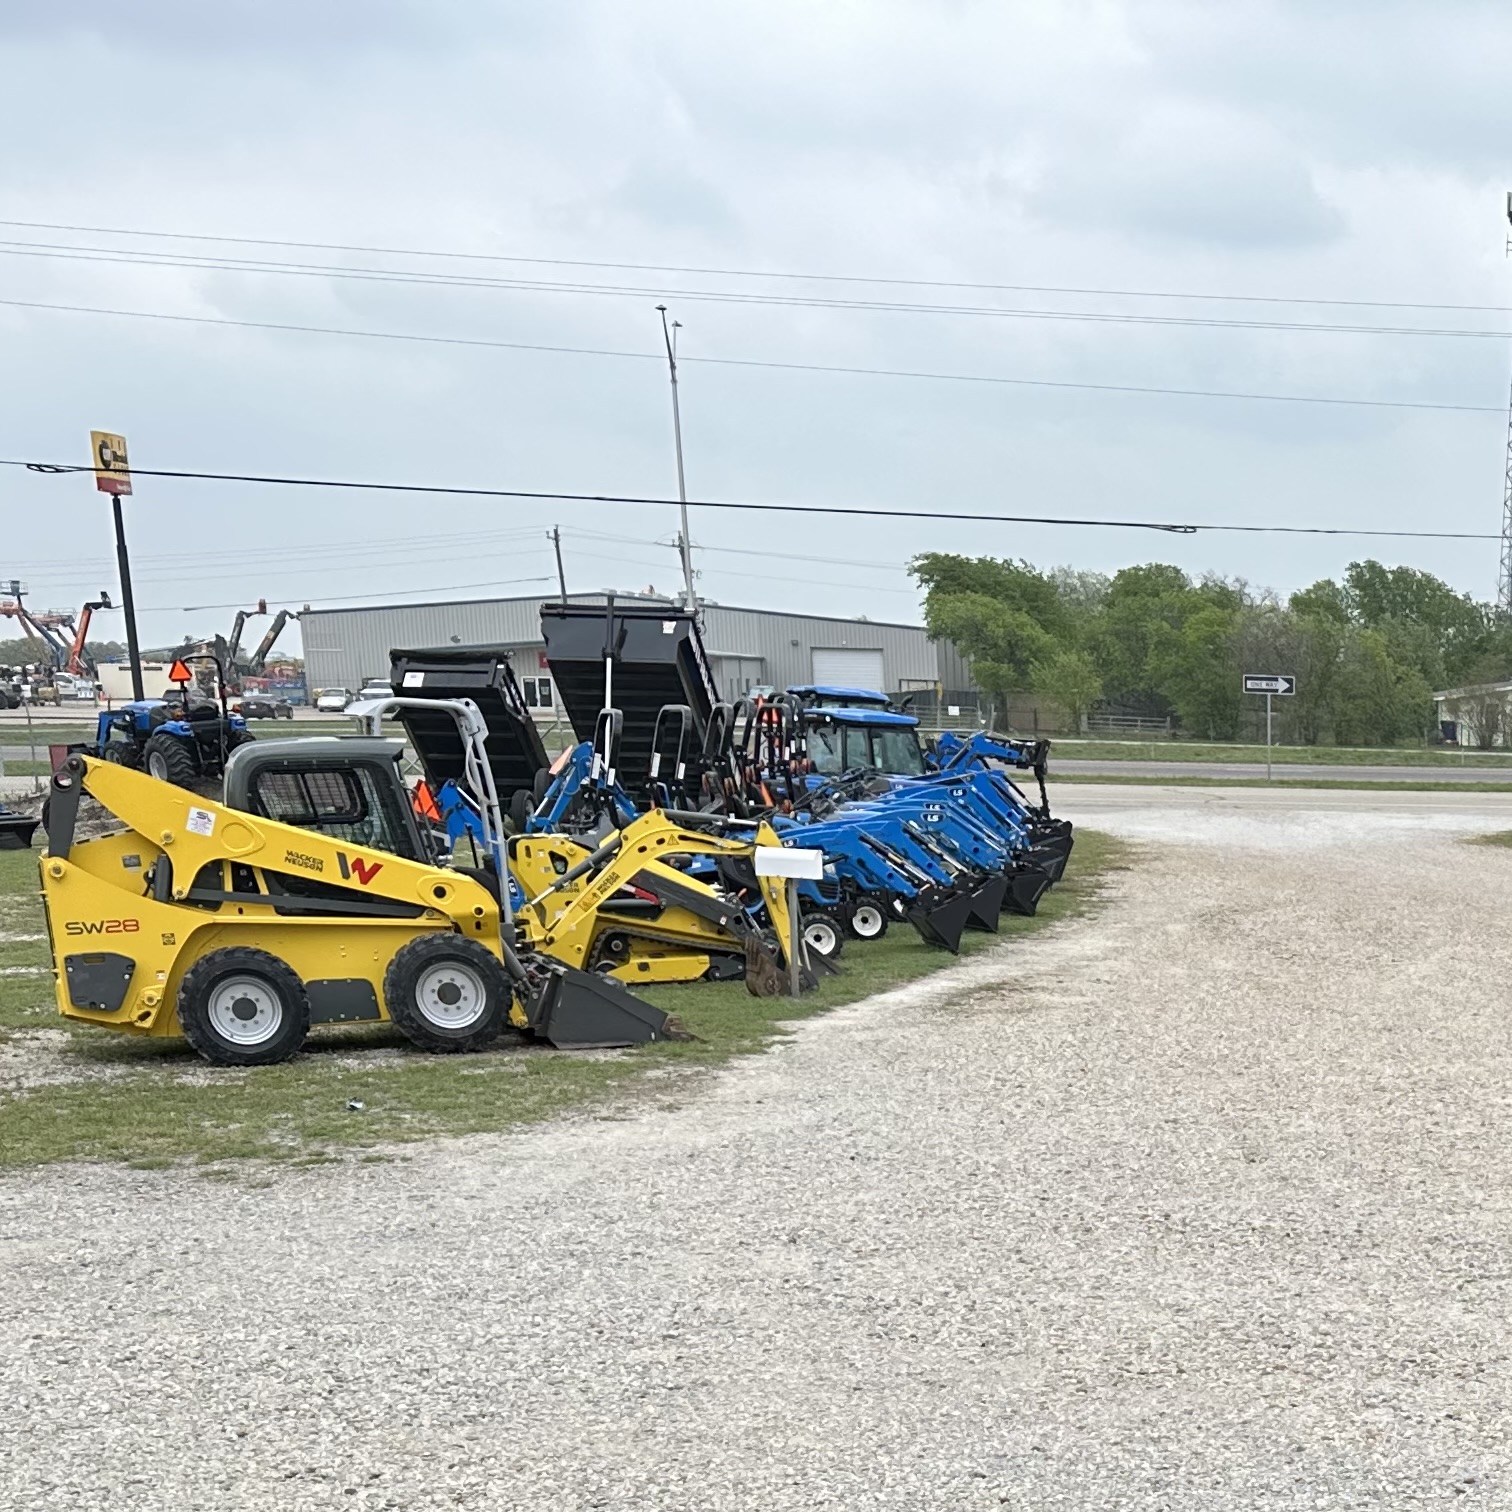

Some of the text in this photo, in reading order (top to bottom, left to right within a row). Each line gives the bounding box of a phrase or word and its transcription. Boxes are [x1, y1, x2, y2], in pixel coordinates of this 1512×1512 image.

[927, 814, 939, 822] LS
[284, 856, 324, 872] NEUSON
[286, 849, 324, 864] WACKER
[65, 919, 140, 936] SW28
